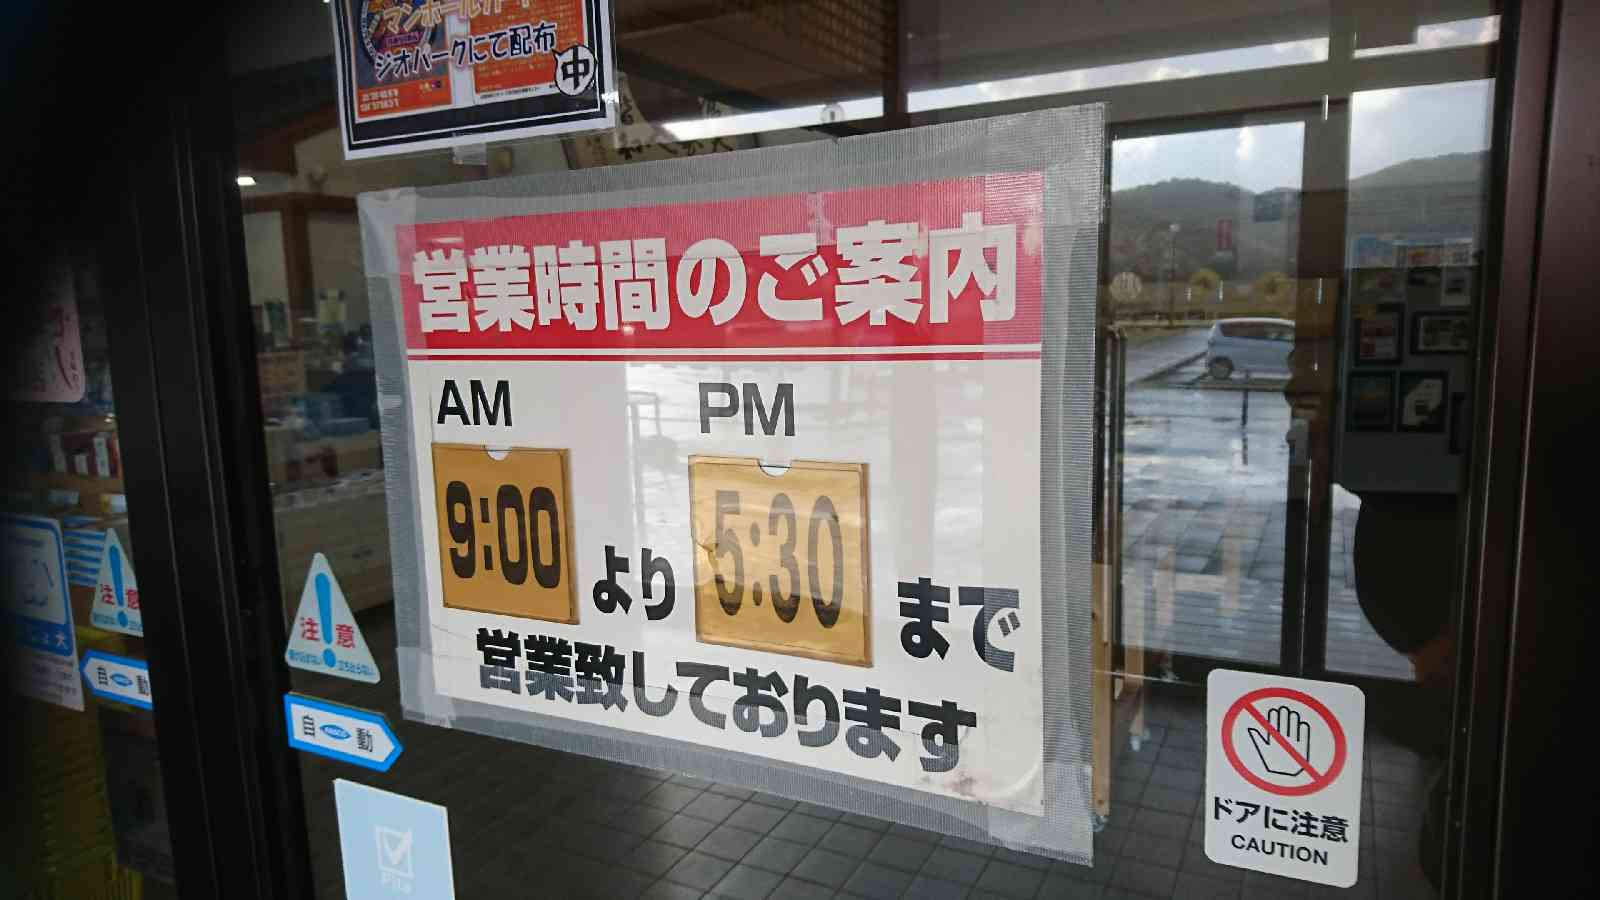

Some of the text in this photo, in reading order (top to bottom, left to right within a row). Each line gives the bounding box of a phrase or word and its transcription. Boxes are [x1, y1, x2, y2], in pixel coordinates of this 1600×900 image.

[376, 22, 557, 80] ジオパークにて配布
[561, 47, 590, 90] 中
[412, 211, 1017, 334] 営業時間のご案内
[436, 379, 797, 437] AM PM
[446, 480, 1022, 673] 9:00 より 5:30 まで
[475, 627, 978, 773] 営業致しております
[1213, 796, 1349, 843] ドアに注意
[1231, 834, 1329, 866] CAUTION
